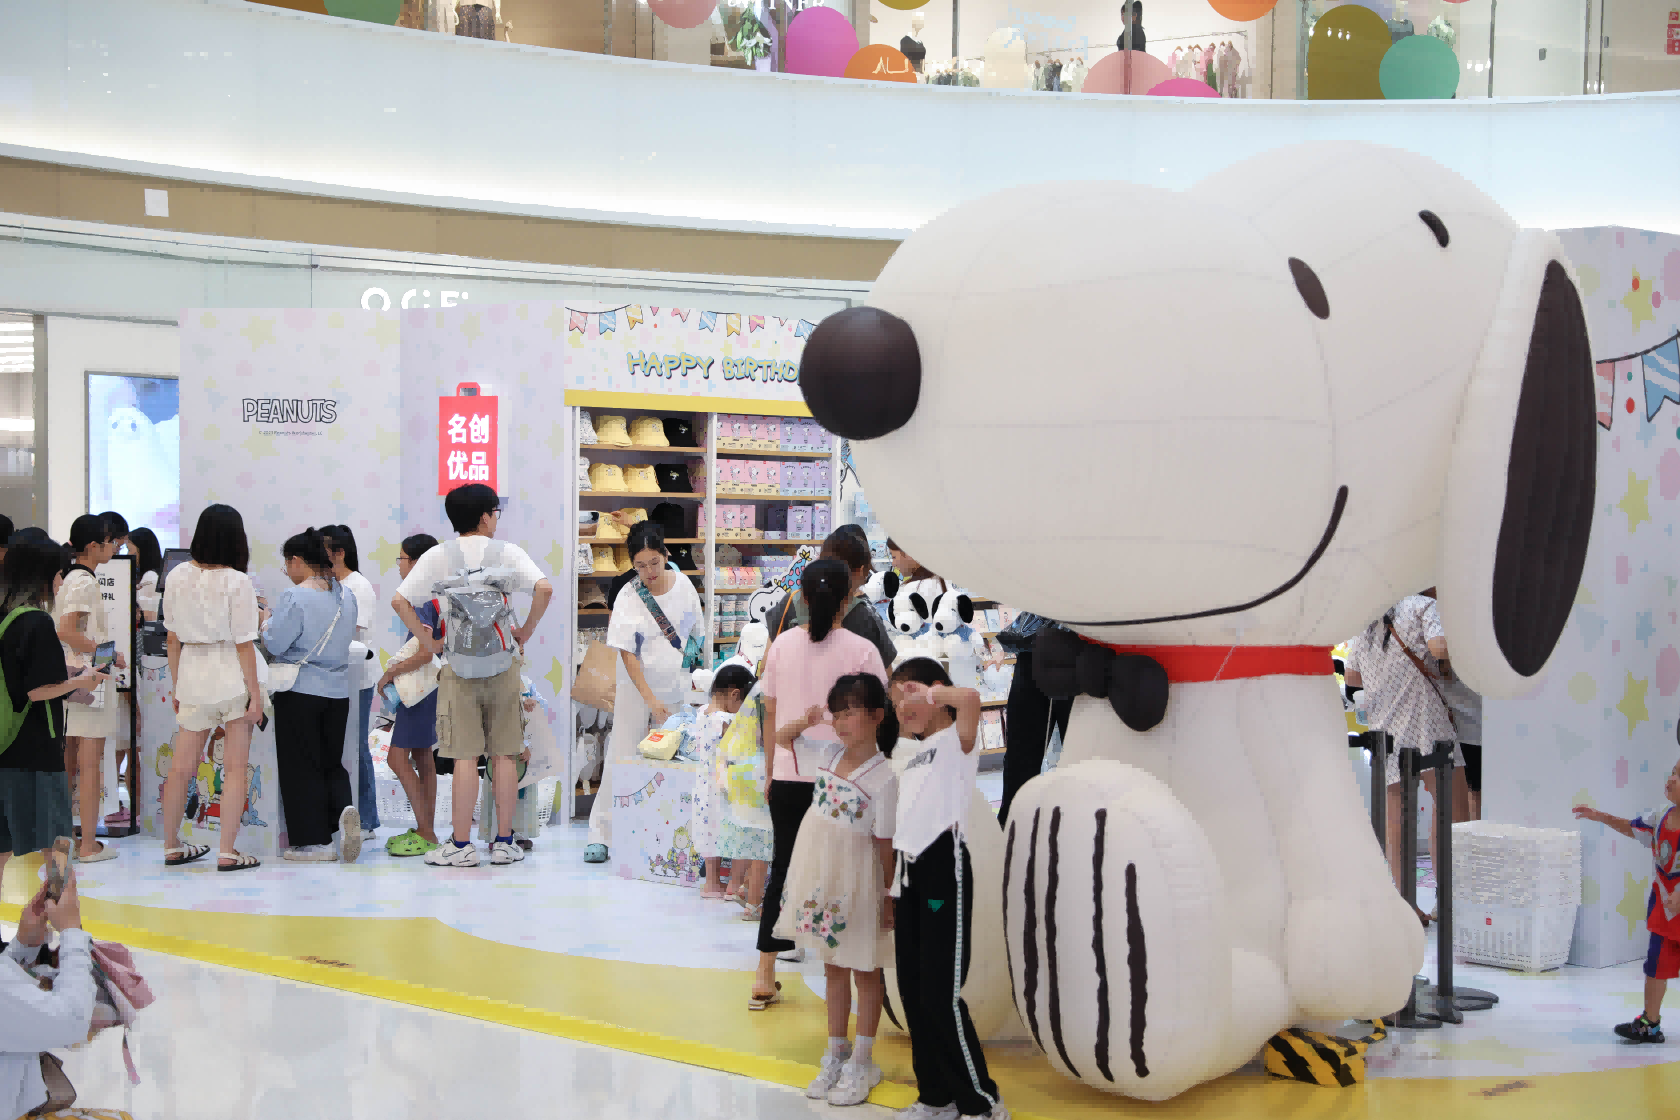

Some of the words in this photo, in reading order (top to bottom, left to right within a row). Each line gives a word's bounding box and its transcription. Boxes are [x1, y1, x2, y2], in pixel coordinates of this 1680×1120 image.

[626, 350, 714, 379] HAPPY
[722, 356, 800, 383] BIRTHD
[242, 398, 337, 423] PEANUTS
[448, 413, 489, 443] 名创
[447, 450, 489, 480] 优品
